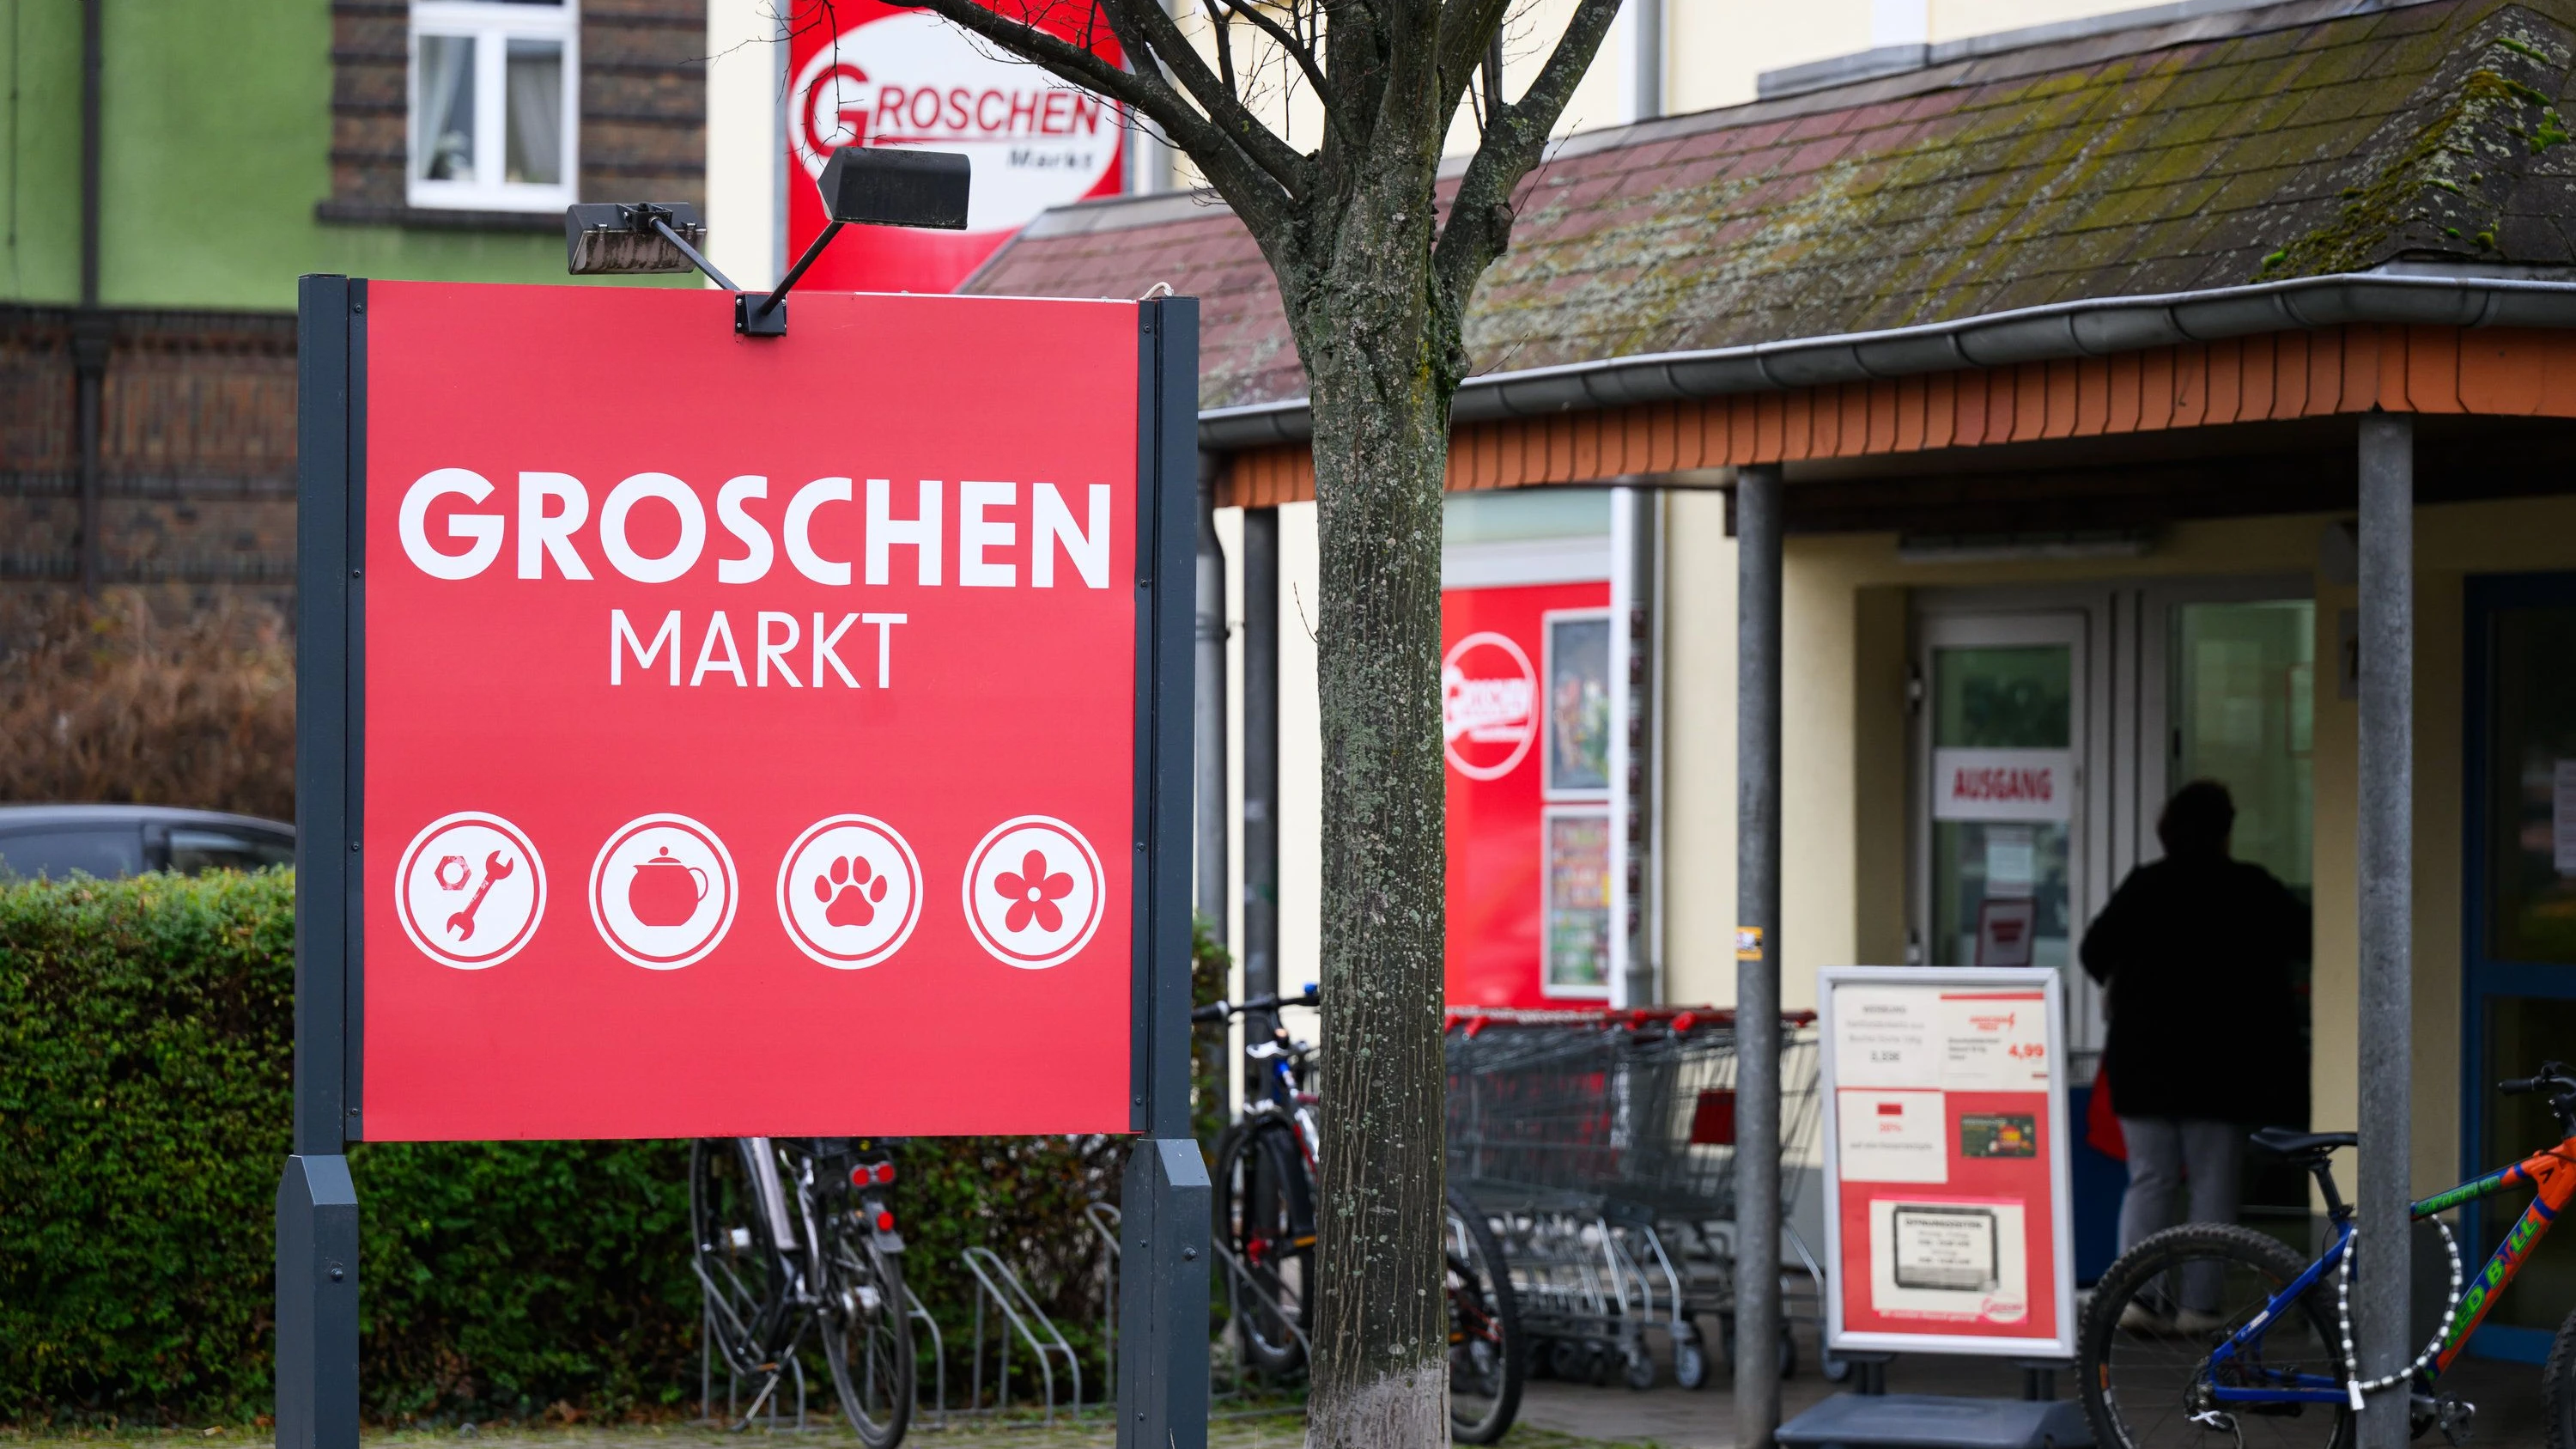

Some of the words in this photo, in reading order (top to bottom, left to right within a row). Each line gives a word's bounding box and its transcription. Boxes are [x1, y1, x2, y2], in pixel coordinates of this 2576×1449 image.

[804, 63, 1100, 157] GROSCHEN
[398, 467, 1111, 589] GROSCHEN
[610, 608, 908, 689] MARKT
[1953, 766, 2052, 802] AUSGANG
[2008, 1043, 2045, 1060] 4,99
